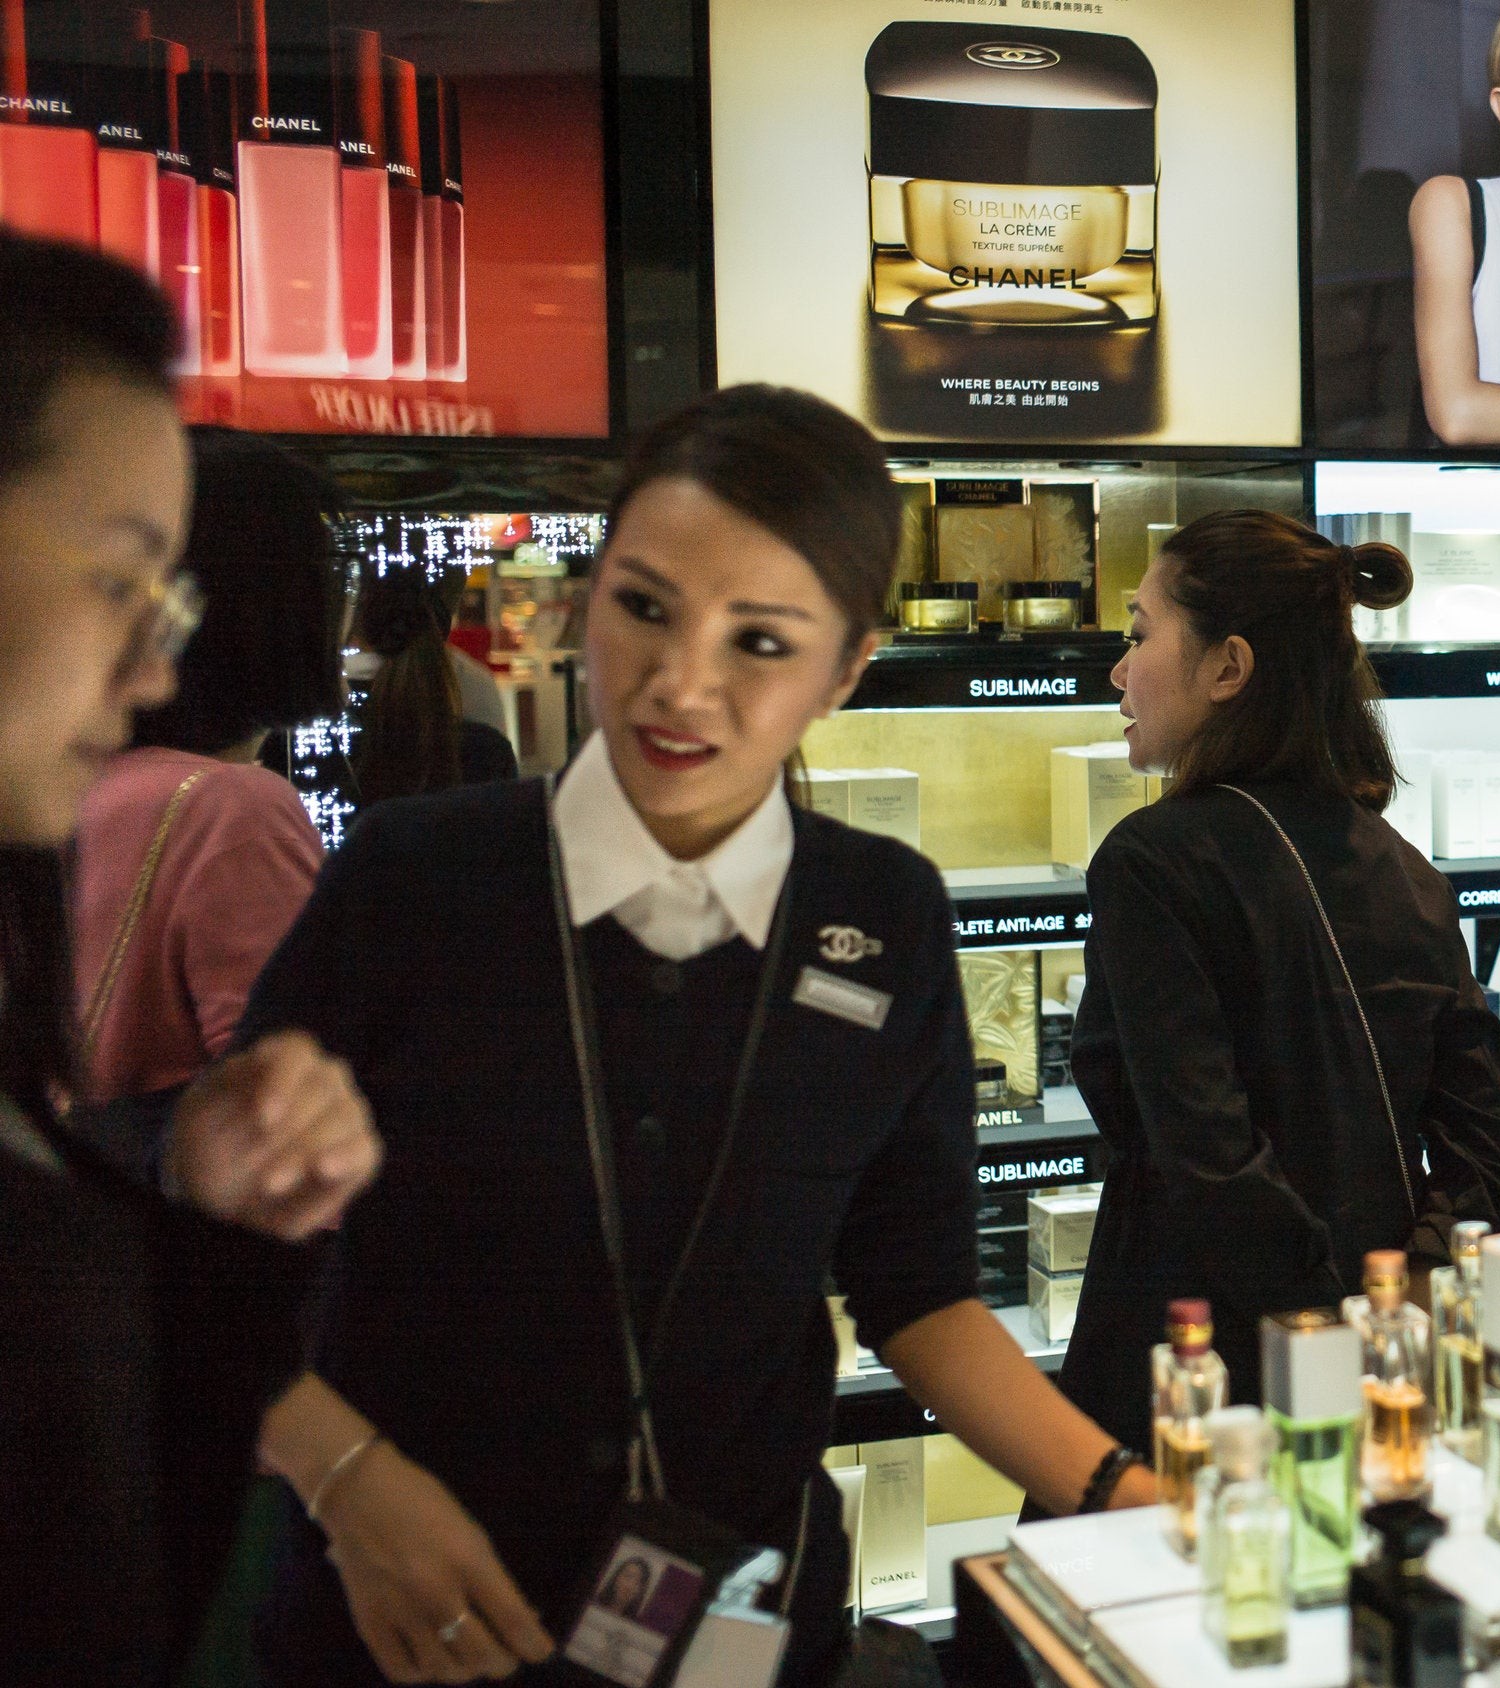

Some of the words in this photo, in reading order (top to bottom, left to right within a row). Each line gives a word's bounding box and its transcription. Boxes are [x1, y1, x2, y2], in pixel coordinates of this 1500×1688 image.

[252, 116, 321, 131] CHANEL
[99, 124, 143, 140] ANEL
[340, 141, 376, 155] ANEL
[156, 149, 191, 166] HANEL
[386, 163, 417, 178] HANEL
[953, 198, 1082, 221] SUBLIMAGE
[980, 223, 1000, 235] LA
[1004, 223, 1056, 237] CRÈME
[972, 241, 1014, 251] TEXTURE
[949, 265, 1087, 290] CHANEL
[941, 378, 991, 390] WHERE
[995, 379, 1048, 391] BEAUTY
[1050, 380, 1100, 392] BEGINS
[1022, 394, 1068, 407] 由此開始
[969, 678, 1077, 697] SUBLIMAGE
[952, 919, 994, 936] PLETE
[996, 915, 1065, 934] ANTI-AGE
[976, 1109, 1023, 1127] ANEL
[977, 1156, 1085, 1184] SUBLIMAGE
[870, 1569, 918, 1586] CHANEL
